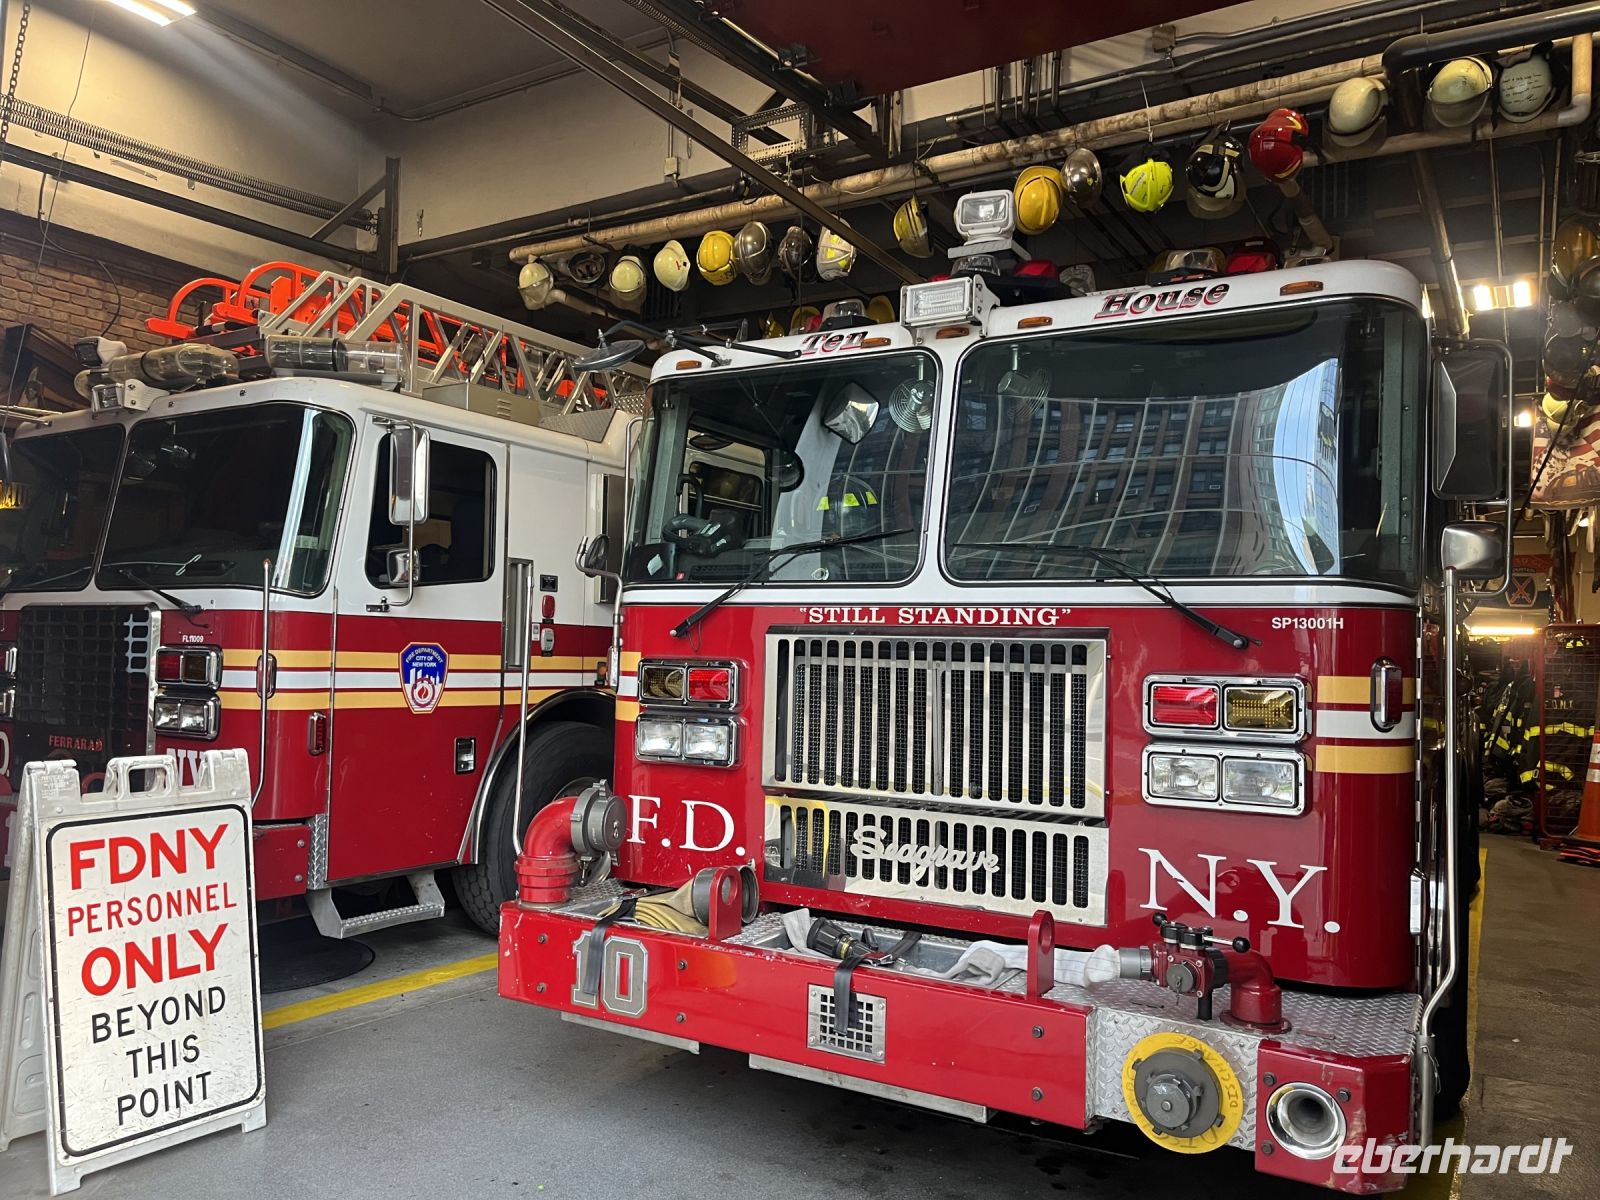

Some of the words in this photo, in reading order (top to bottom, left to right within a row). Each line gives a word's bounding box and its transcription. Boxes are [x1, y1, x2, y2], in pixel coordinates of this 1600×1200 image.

[801, 331, 868, 357] Ten
[1094, 284, 1230, 319] House
[1270, 616, 1345, 630] SP13001H
[415, 647, 443, 663] DEPARTMENT
[69, 824, 229, 890] FDNY
[850, 825, 1000, 882] Seagrave
[67, 882, 237, 936] PERSONNEL
[81, 923, 229, 997] ONLY
[572, 930, 648, 1018] 10
[92, 985, 226, 1043] BEYOND
[126, 1034, 201, 1078] THIS
[117, 1071, 212, 1125] POINT
